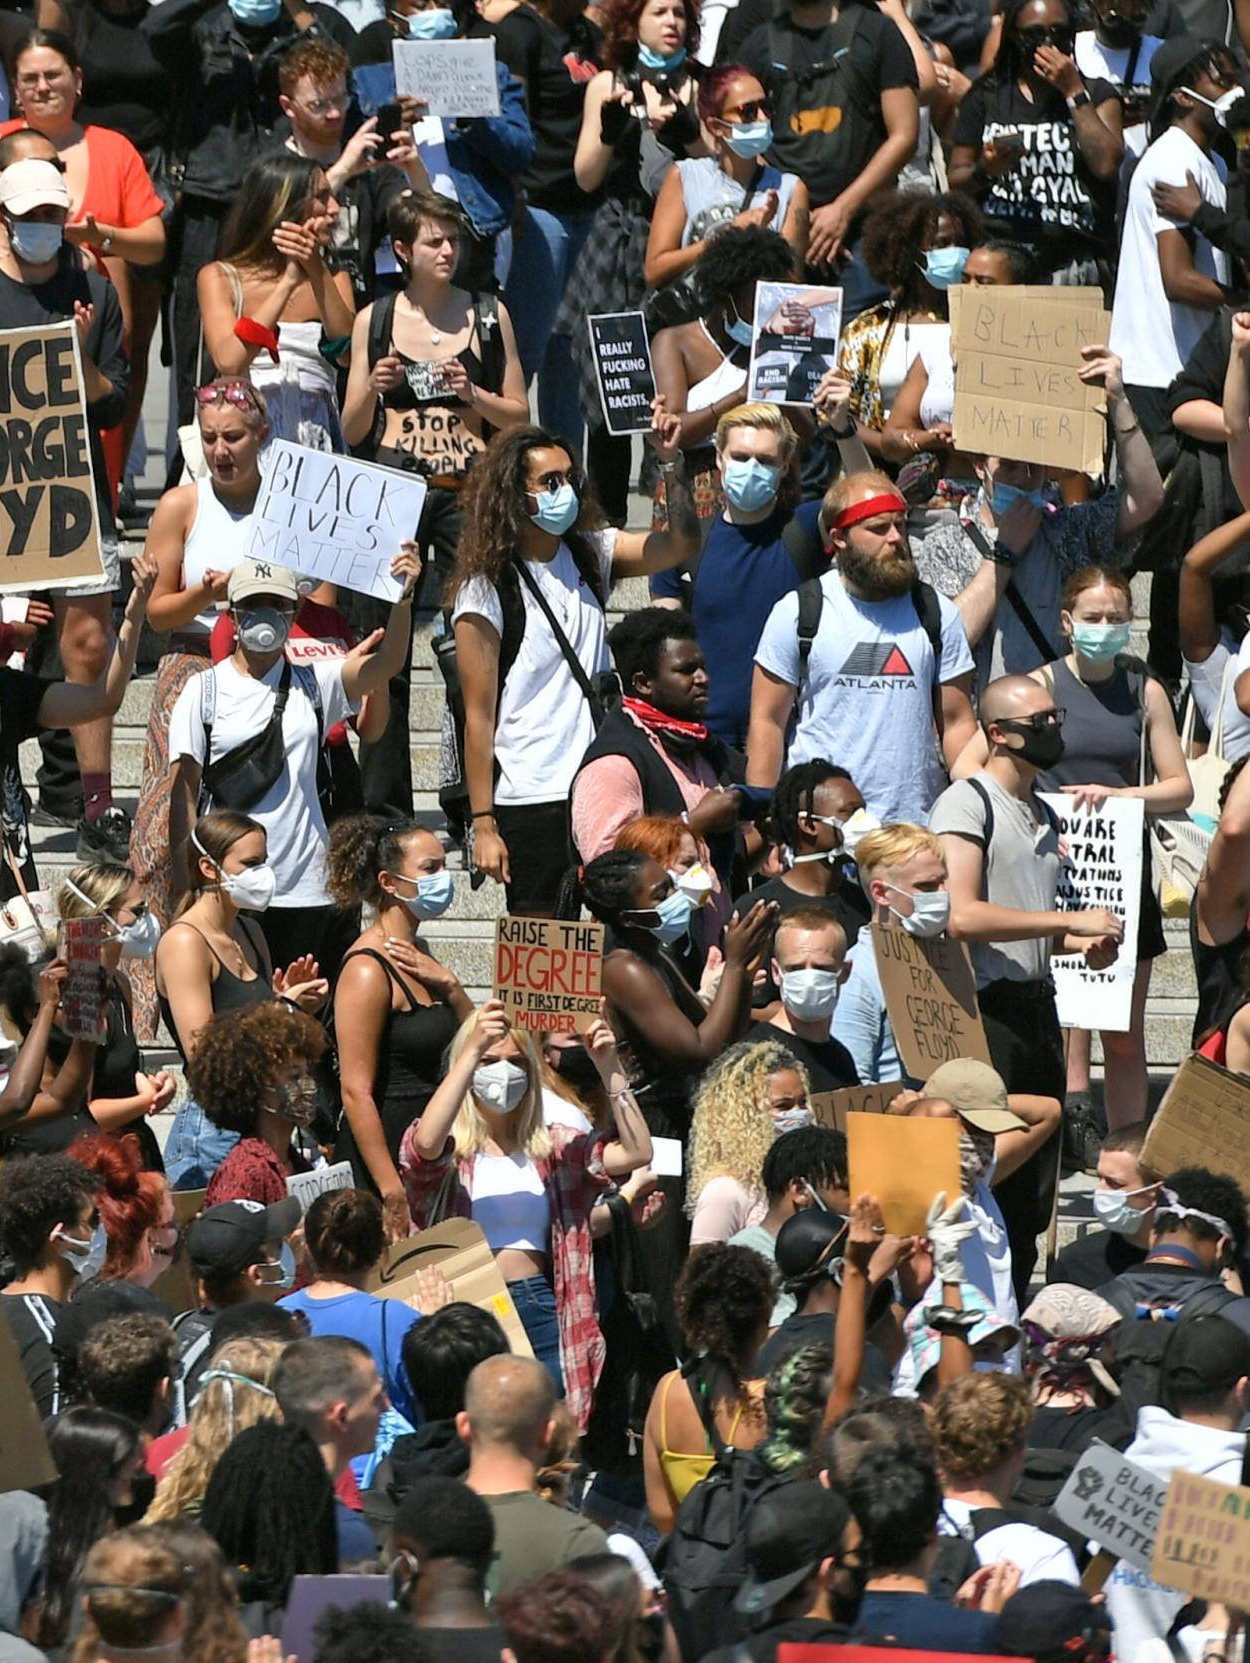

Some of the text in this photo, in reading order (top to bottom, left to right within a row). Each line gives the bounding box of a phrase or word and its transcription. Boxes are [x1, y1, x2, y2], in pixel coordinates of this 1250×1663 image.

[595, 326, 601, 339] I
[974, 304, 1098, 350] BLACK
[599, 341, 633, 357] REALLY
[602, 357, 646, 374] FUCKING
[981, 360, 1075, 393] LIVES
[605, 377, 631, 391] HATE
[608, 394, 649, 408] RACISTS.
[402, 411, 461, 434] STOP
[972, 405, 1072, 445] MATTER
[394, 436, 478, 456] KILLING
[270, 451, 403, 527] BLACK
[262, 495, 383, 550] LIVES
[250, 526, 391, 597] MATTER
[833, 677, 918, 690] ATLANTA
[1071, 843, 1116, 863] TRAL
[498, 918, 601, 952] RAISE THE
[497, 943, 602, 996] DEGREE
[909, 966, 937, 993] FOR
[1079, 972, 1116, 983] TUTU
[498, 989, 601, 1014] IT IS FIRST DEGREE
[906, 995, 964, 1035] GEORGE
[515, 1010, 578, 1034] MURDER
[913, 1029, 961, 1061] FLOYD
[1115, 1467, 1167, 1507] BLAC
[1105, 1486, 1159, 1532] LIVE
[1082, 1503, 1155, 1556] MATTE
